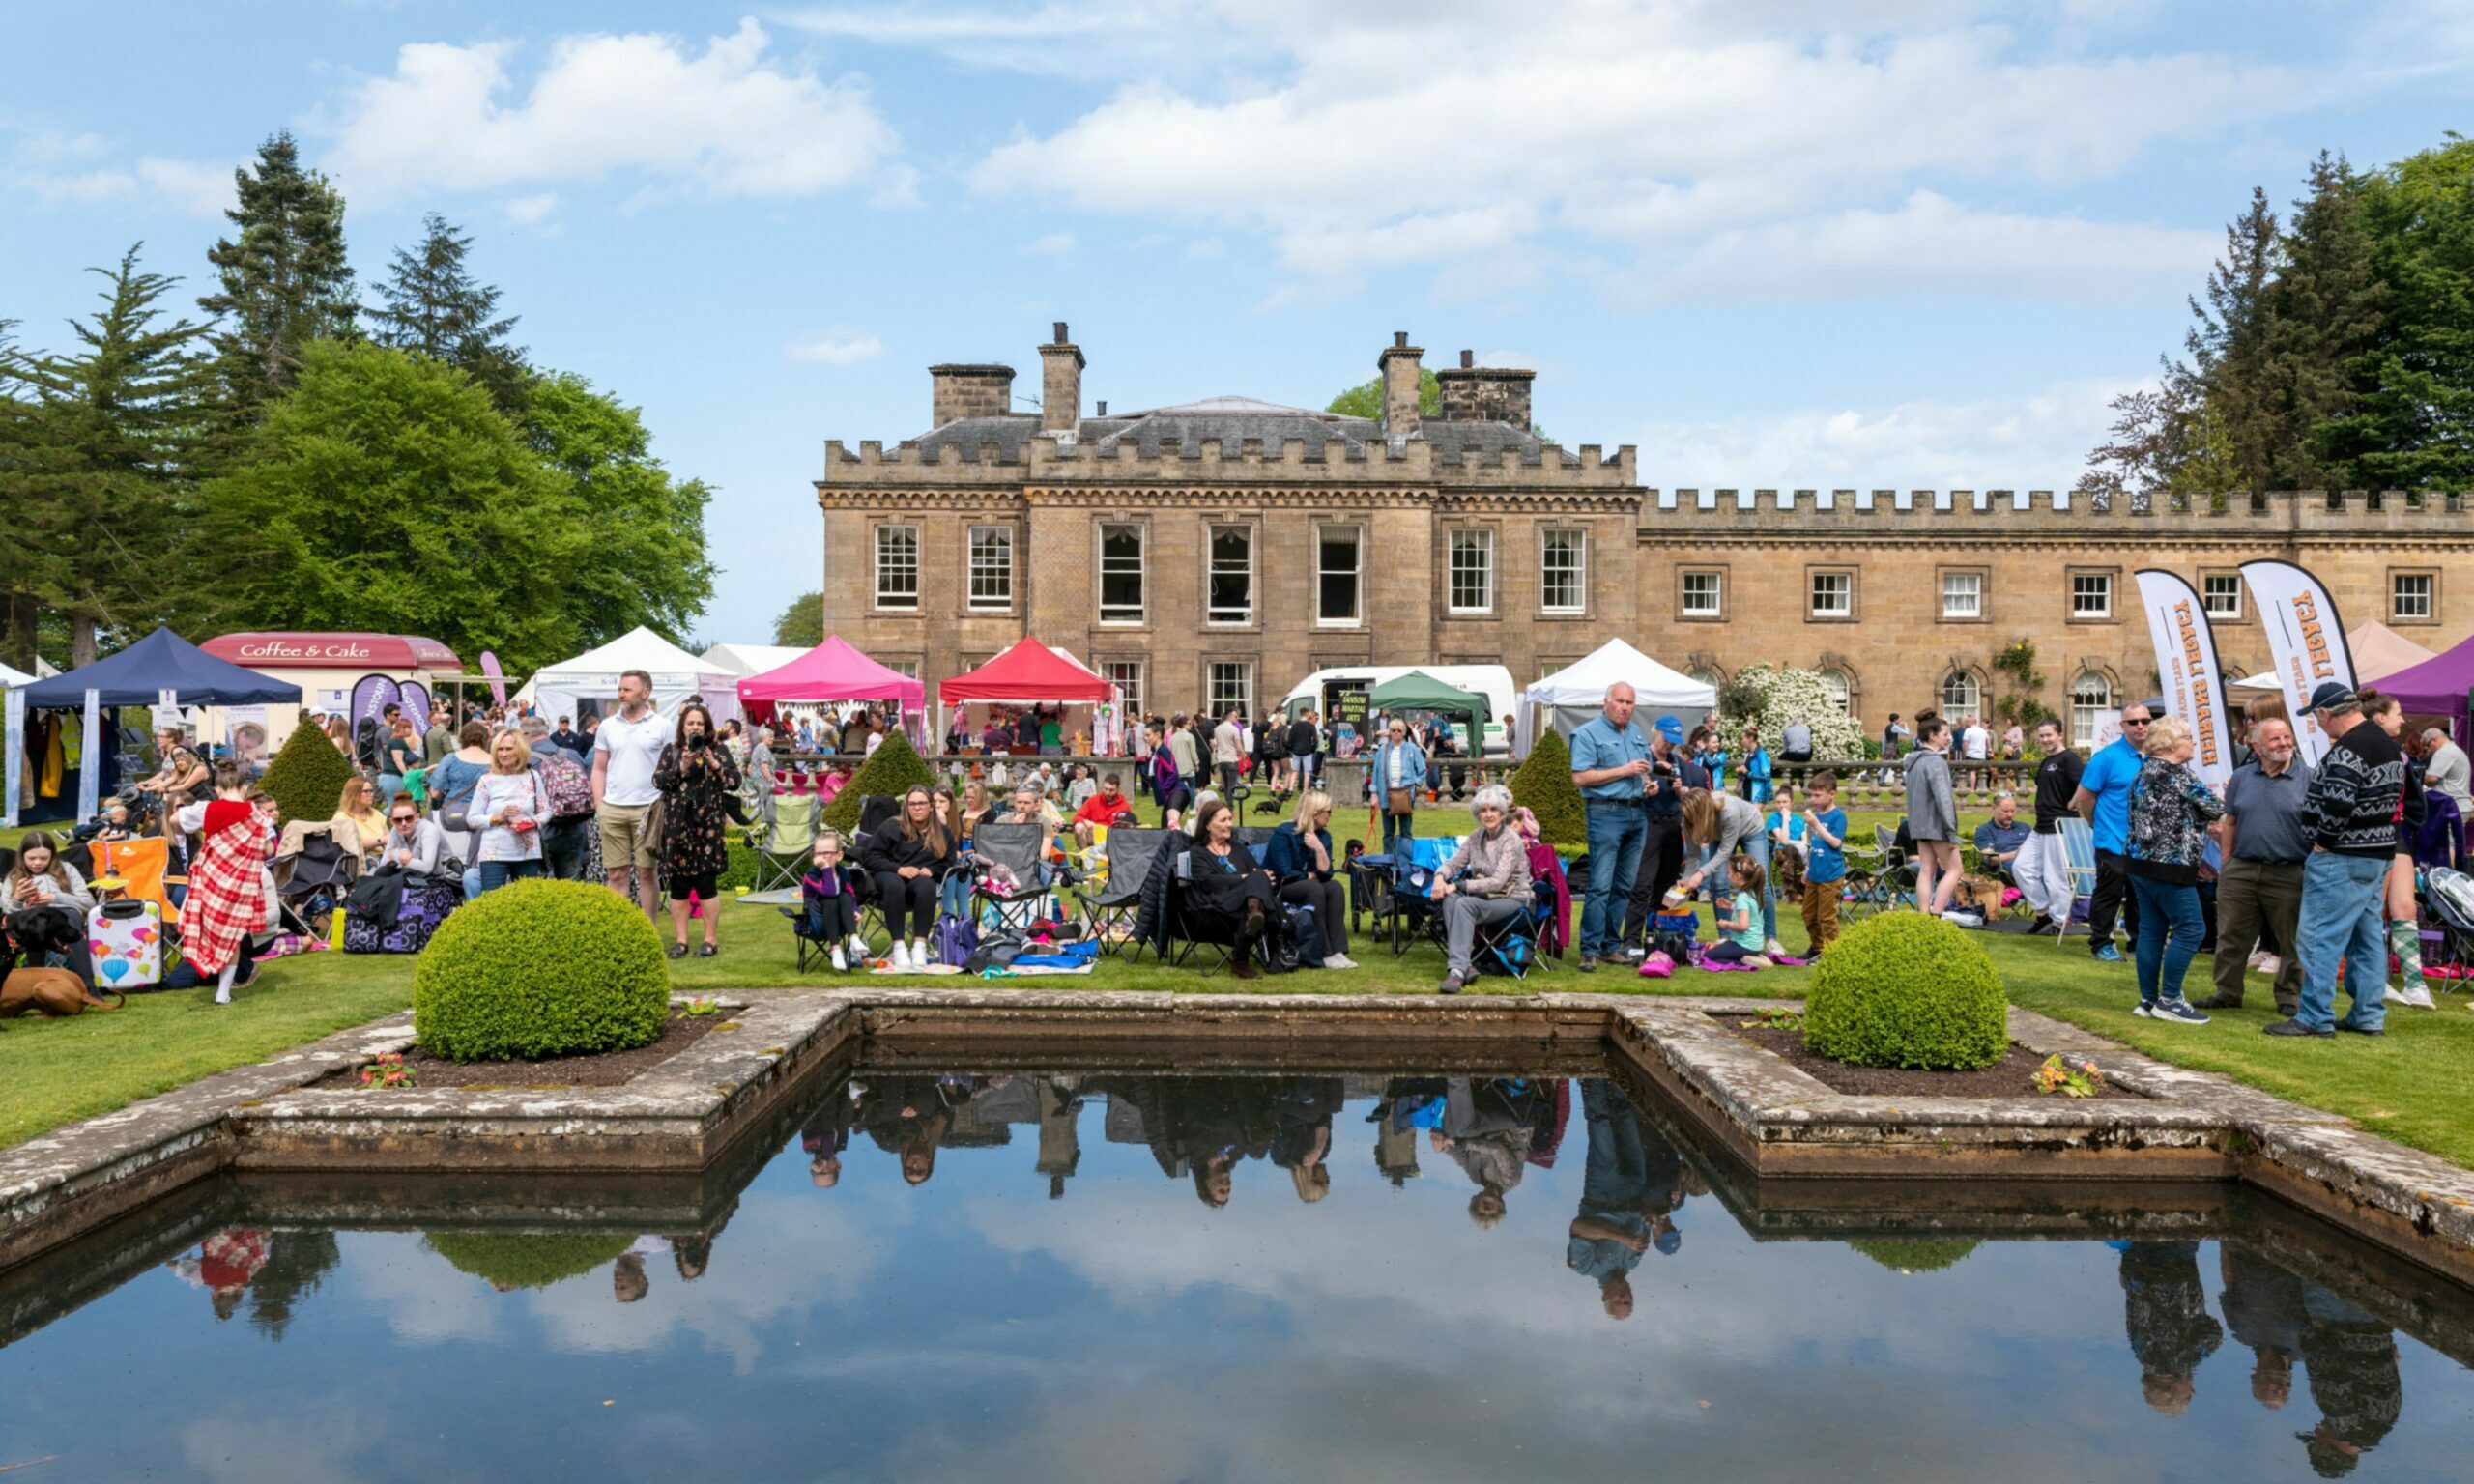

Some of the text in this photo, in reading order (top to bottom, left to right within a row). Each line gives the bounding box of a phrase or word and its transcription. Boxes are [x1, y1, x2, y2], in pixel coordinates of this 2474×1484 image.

[240, 641, 371, 658] Coffee & Cake
[365, 677, 388, 718] NSTOUN
